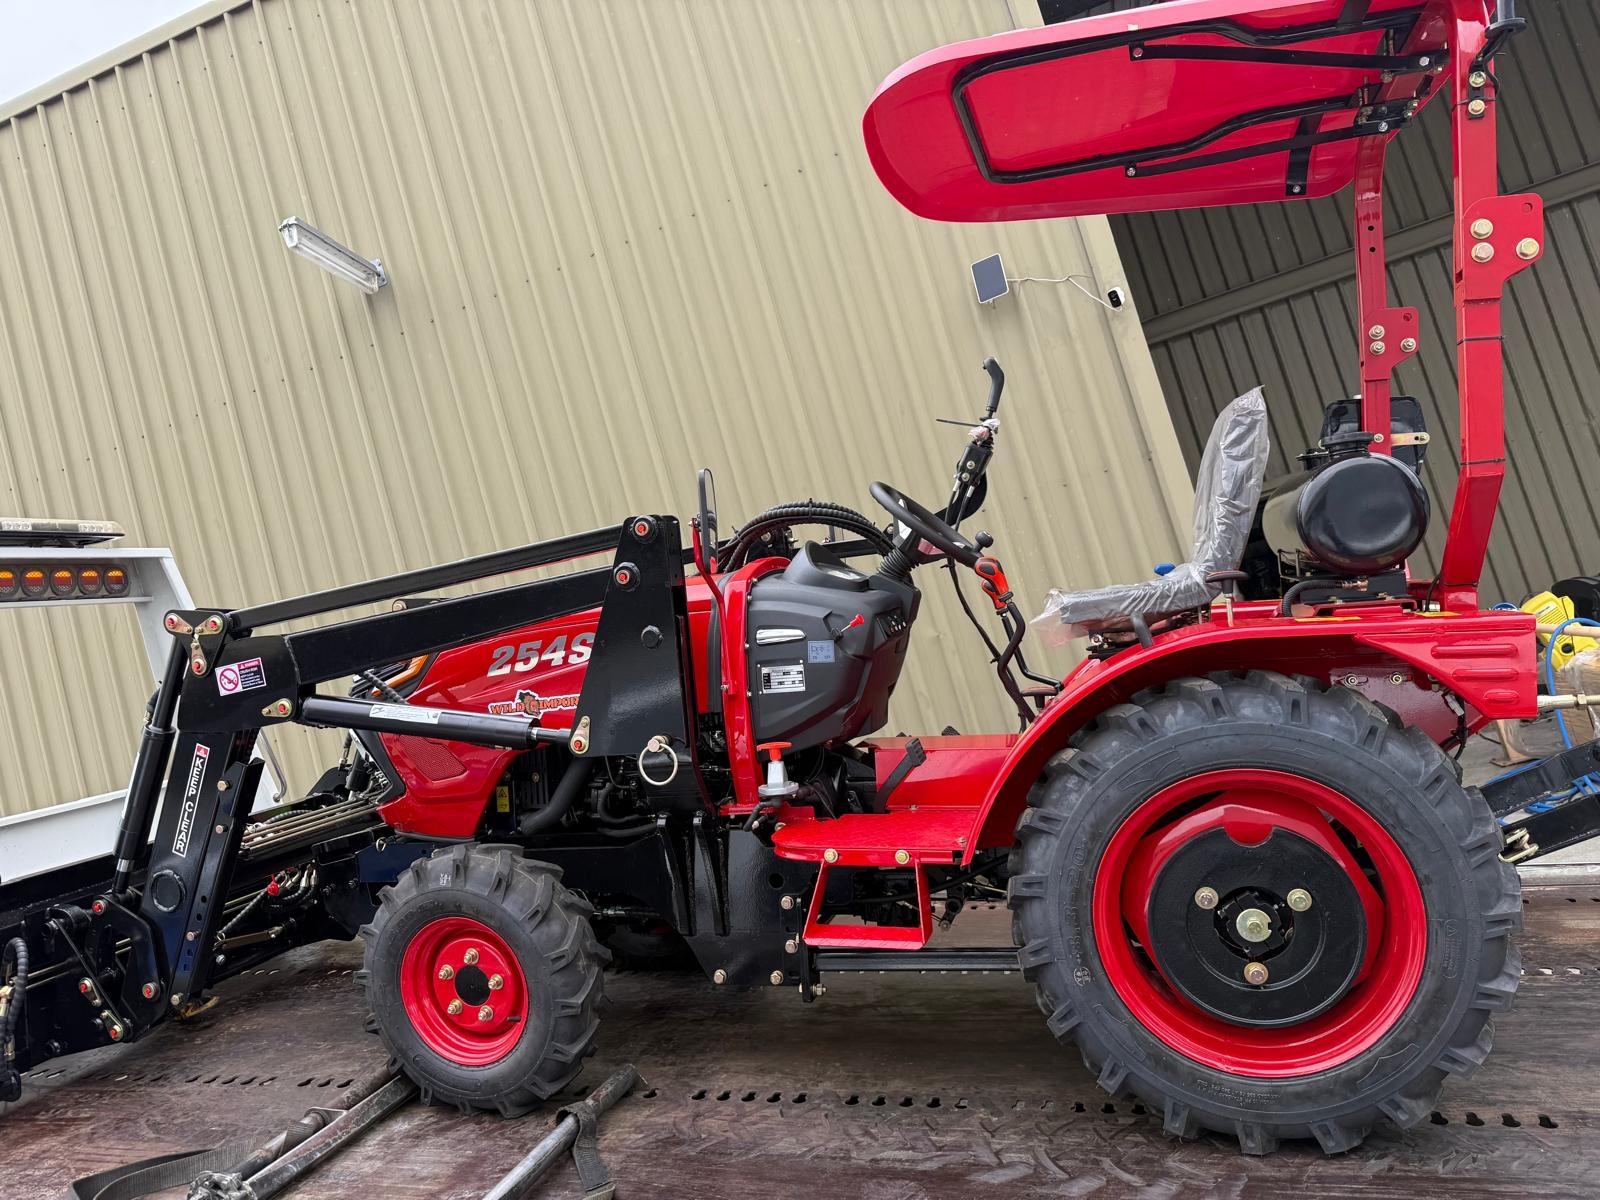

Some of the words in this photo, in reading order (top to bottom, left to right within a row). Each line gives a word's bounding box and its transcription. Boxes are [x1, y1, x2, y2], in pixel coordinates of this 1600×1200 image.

[487, 632, 595, 677] 254S
[490, 702, 525, 715] WILD
[188, 757, 202, 797] KEEP
[175, 801, 194, 853] CLEAR
